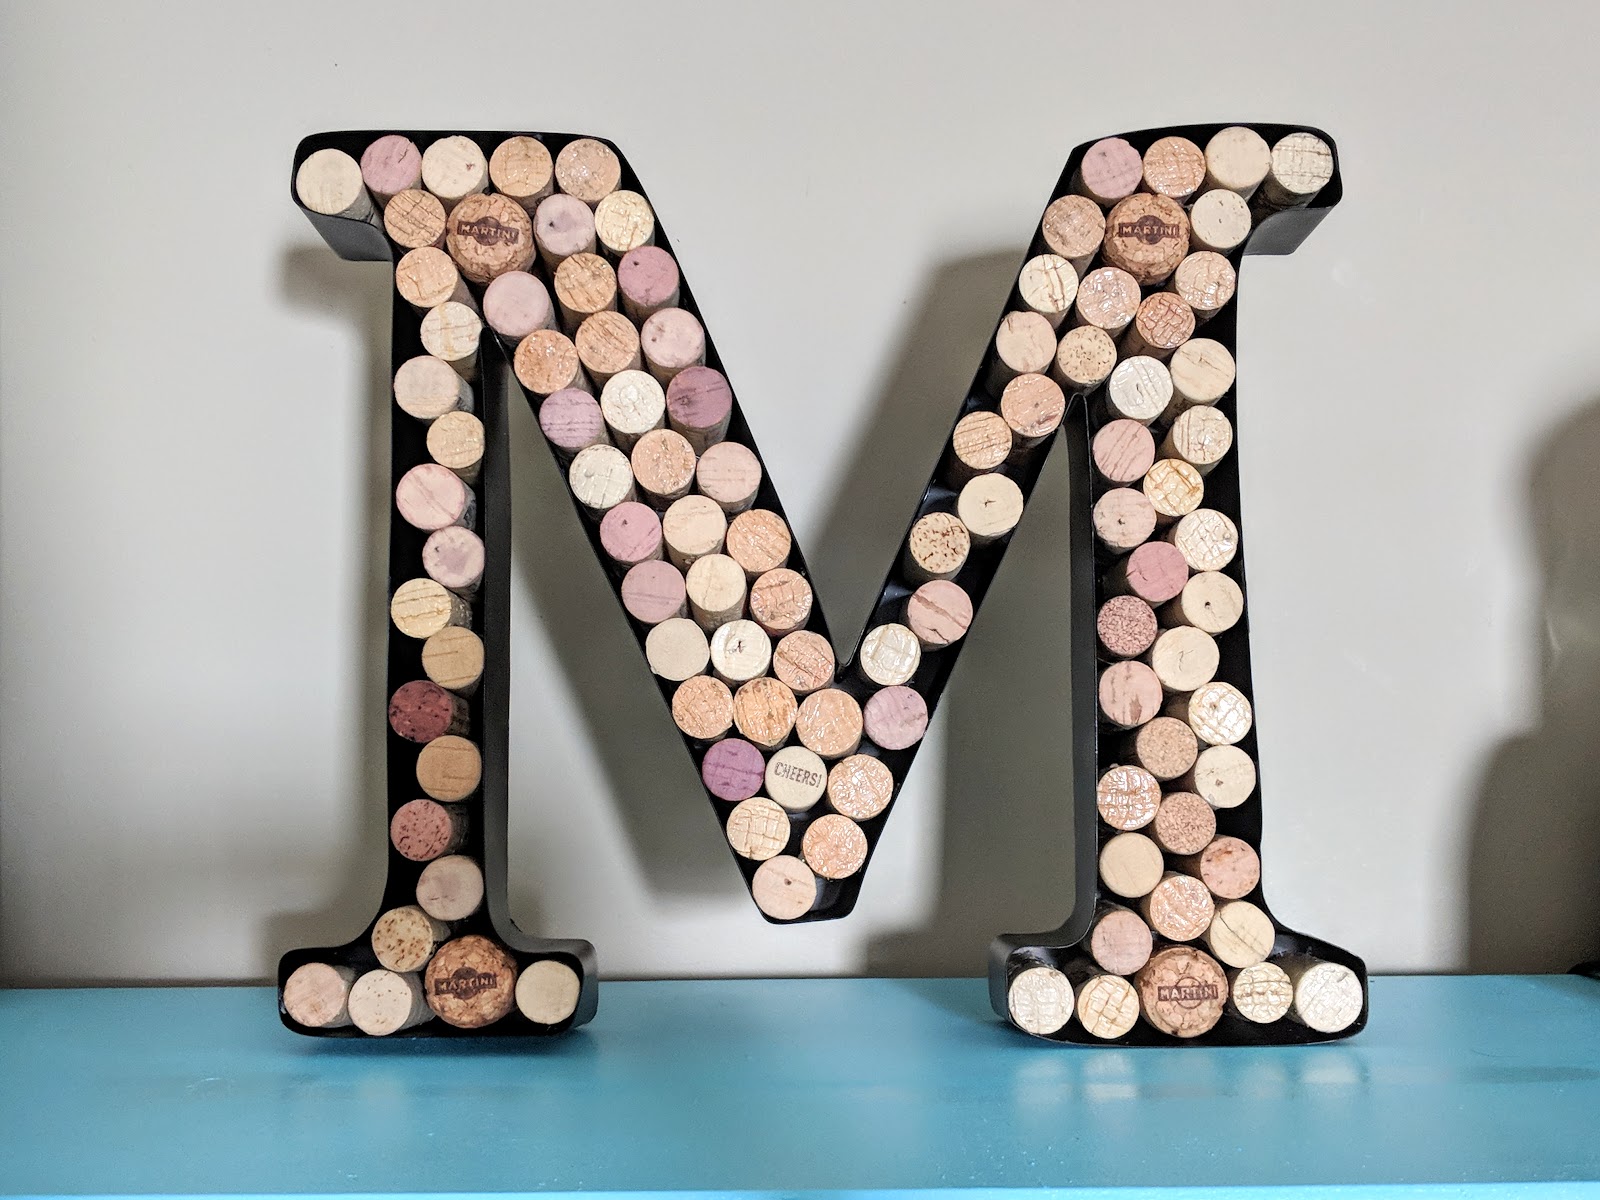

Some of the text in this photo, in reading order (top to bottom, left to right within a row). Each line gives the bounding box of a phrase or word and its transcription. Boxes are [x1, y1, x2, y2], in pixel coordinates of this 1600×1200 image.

[460, 223, 517, 240] MARTINI
[1121, 225, 1178, 236] MARTINI
[774, 761, 823, 788] CHEERS!
[1159, 984, 1217, 1000] MARTINI
